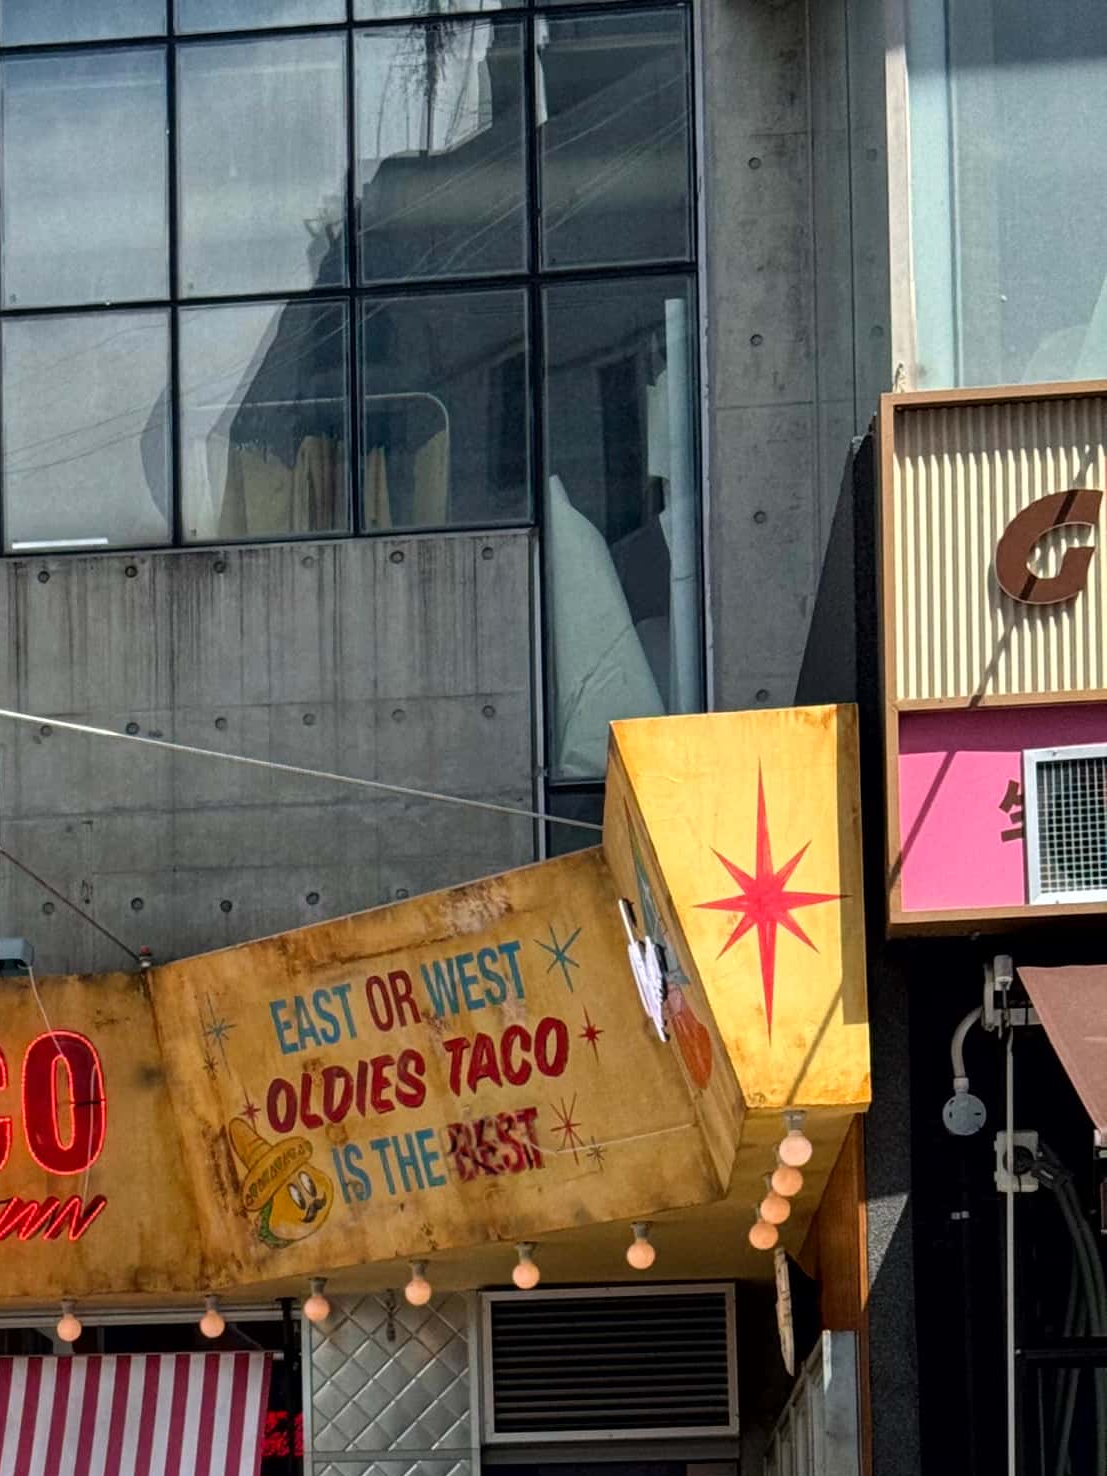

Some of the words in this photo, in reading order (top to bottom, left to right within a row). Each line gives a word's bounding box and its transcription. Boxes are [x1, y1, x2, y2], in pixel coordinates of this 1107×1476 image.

[269, 983, 357, 1055] EAST
[365, 970, 421, 1032] OR
[421, 940, 526, 1018] WEST
[266, 1049, 426, 1134] OLDIES
[443, 1016, 570, 1096] TACO
[332, 1142, 372, 1204] IS
[371, 1128, 447, 1195] THE
[446, 1106, 545, 1182] BEST
